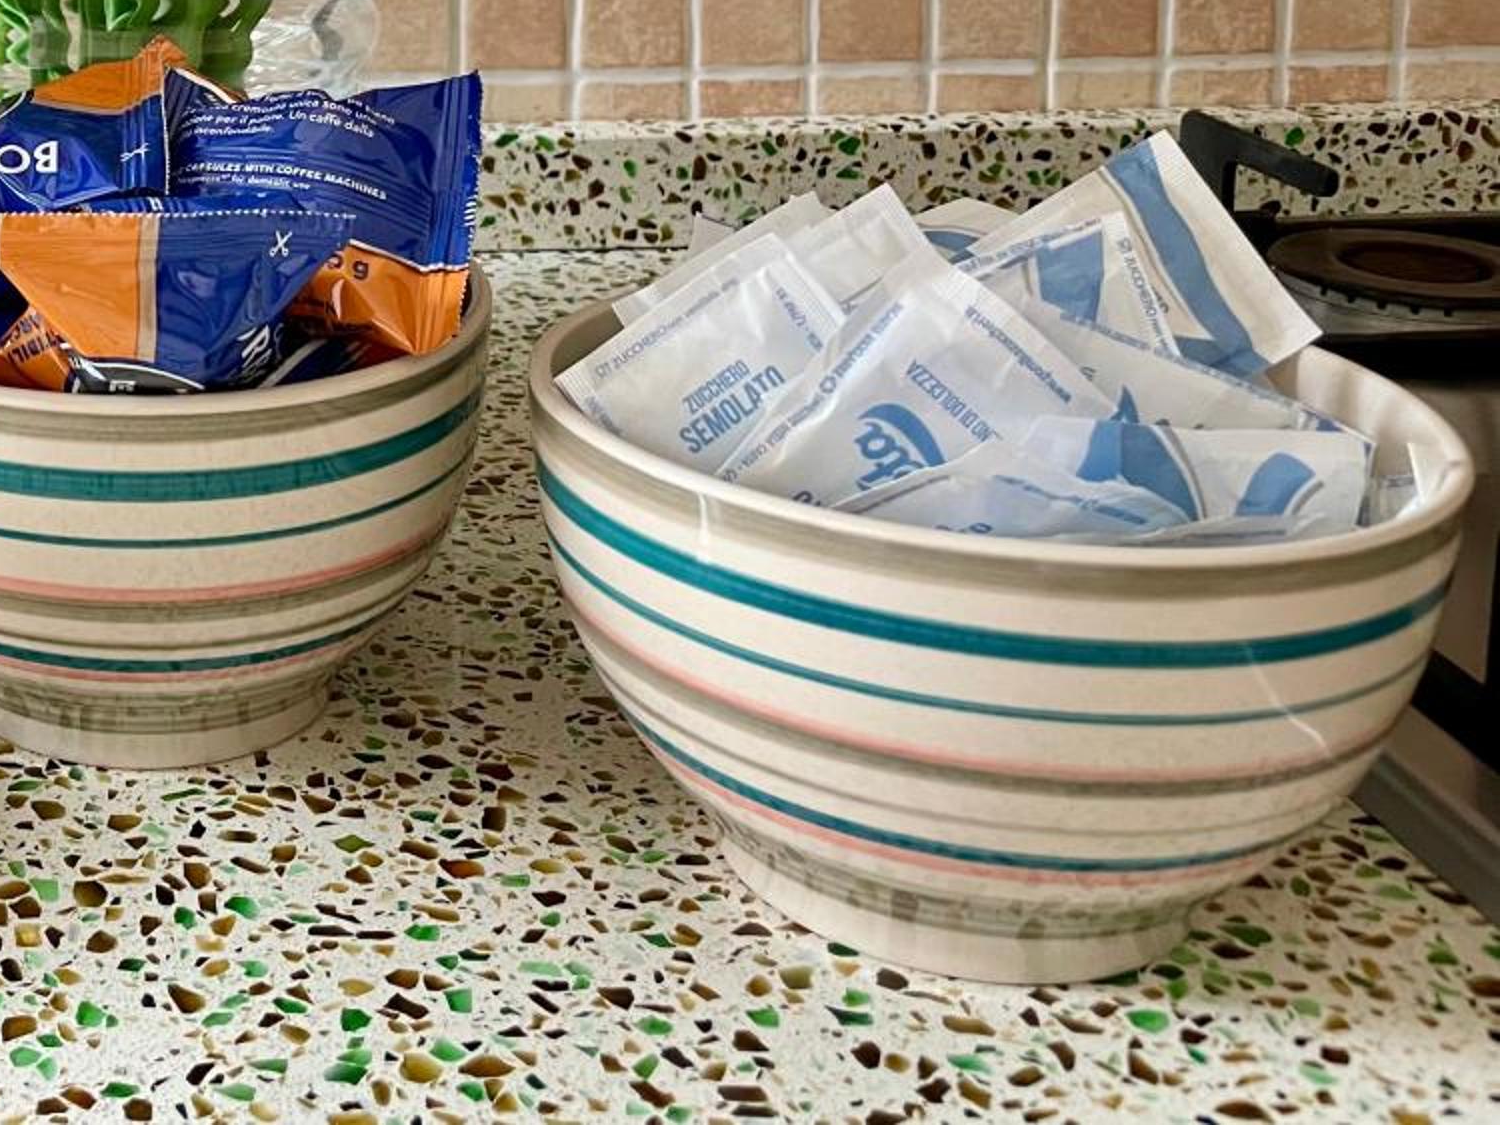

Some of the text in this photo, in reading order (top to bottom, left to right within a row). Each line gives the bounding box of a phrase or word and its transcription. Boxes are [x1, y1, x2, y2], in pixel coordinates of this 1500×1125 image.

[244, 163, 274, 174] WITH
[276, 164, 322, 180] COFFEE
[323, 171, 388, 201] MACHINES
[682, 359, 749, 414] ZUCCHERO
